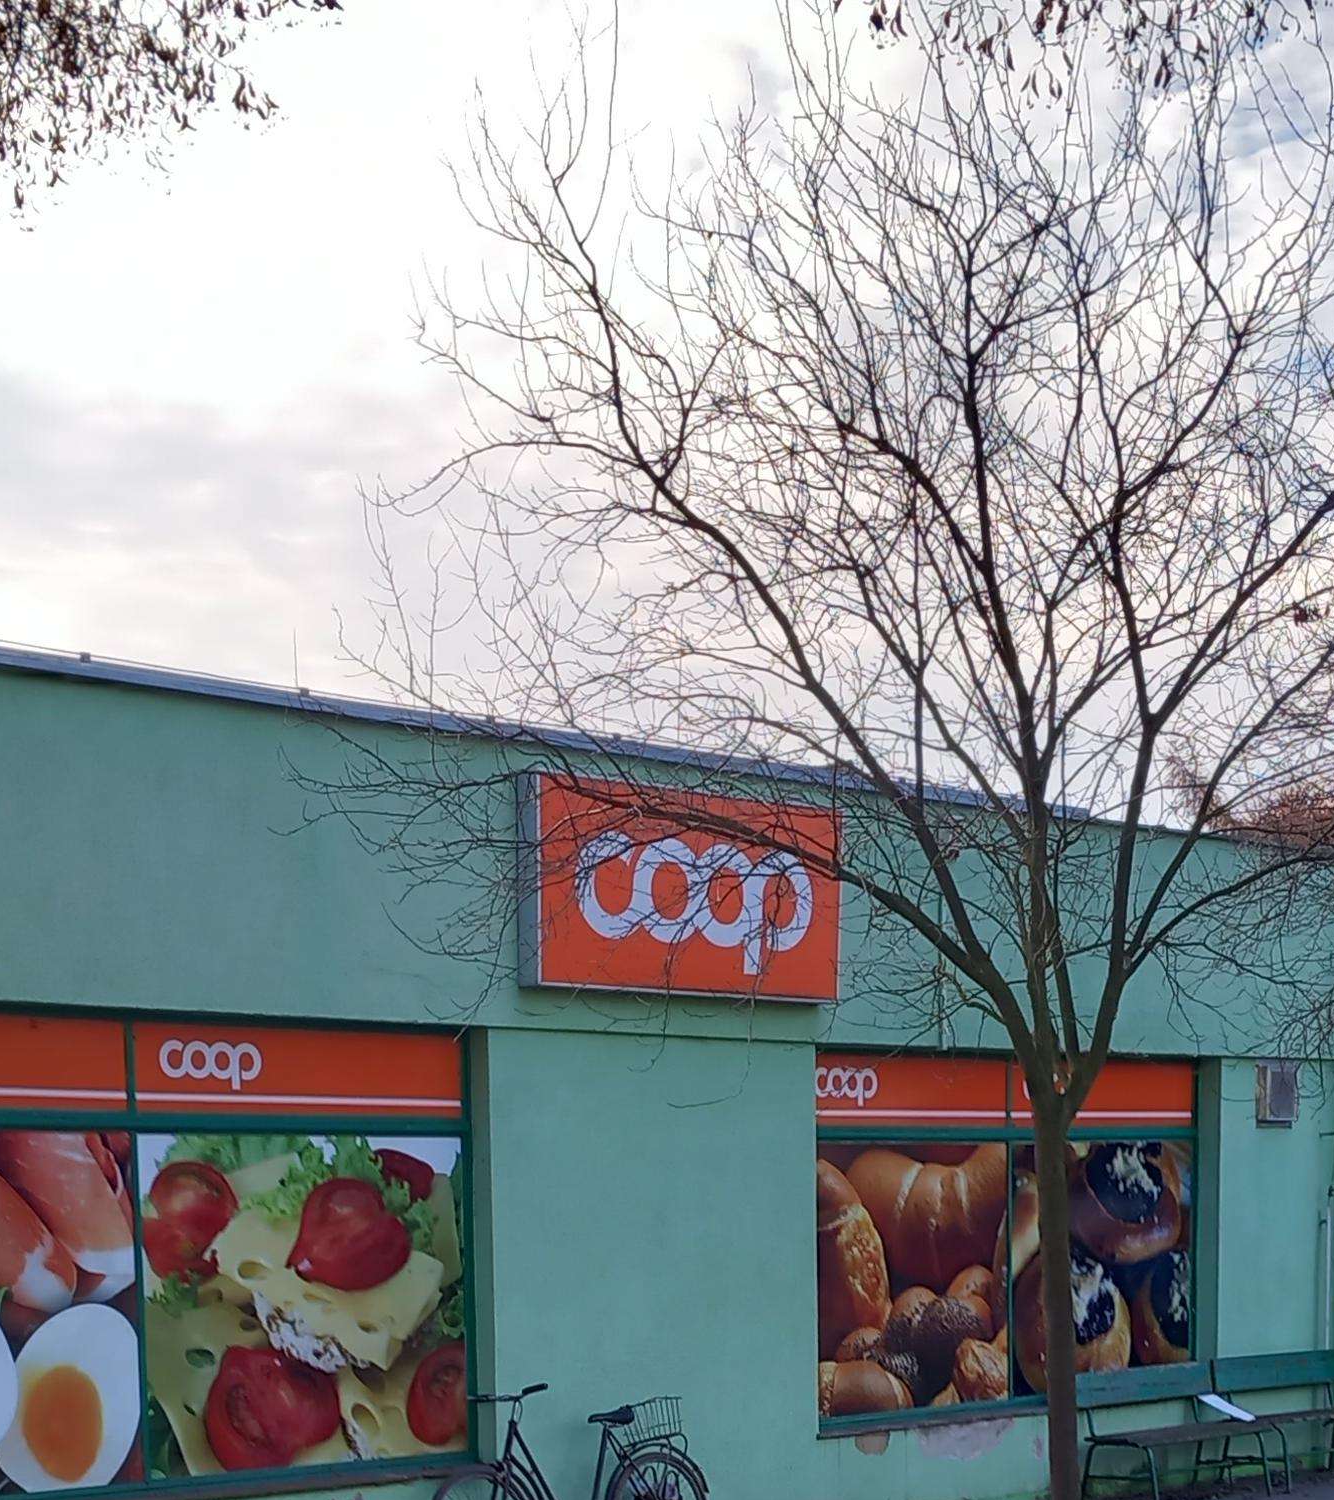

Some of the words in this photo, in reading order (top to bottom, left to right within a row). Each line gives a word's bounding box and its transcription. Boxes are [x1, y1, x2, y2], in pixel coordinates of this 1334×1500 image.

[575, 831, 812, 975] coop
[159, 1040, 262, 1090] coop
[815, 1067, 878, 1107] coop
